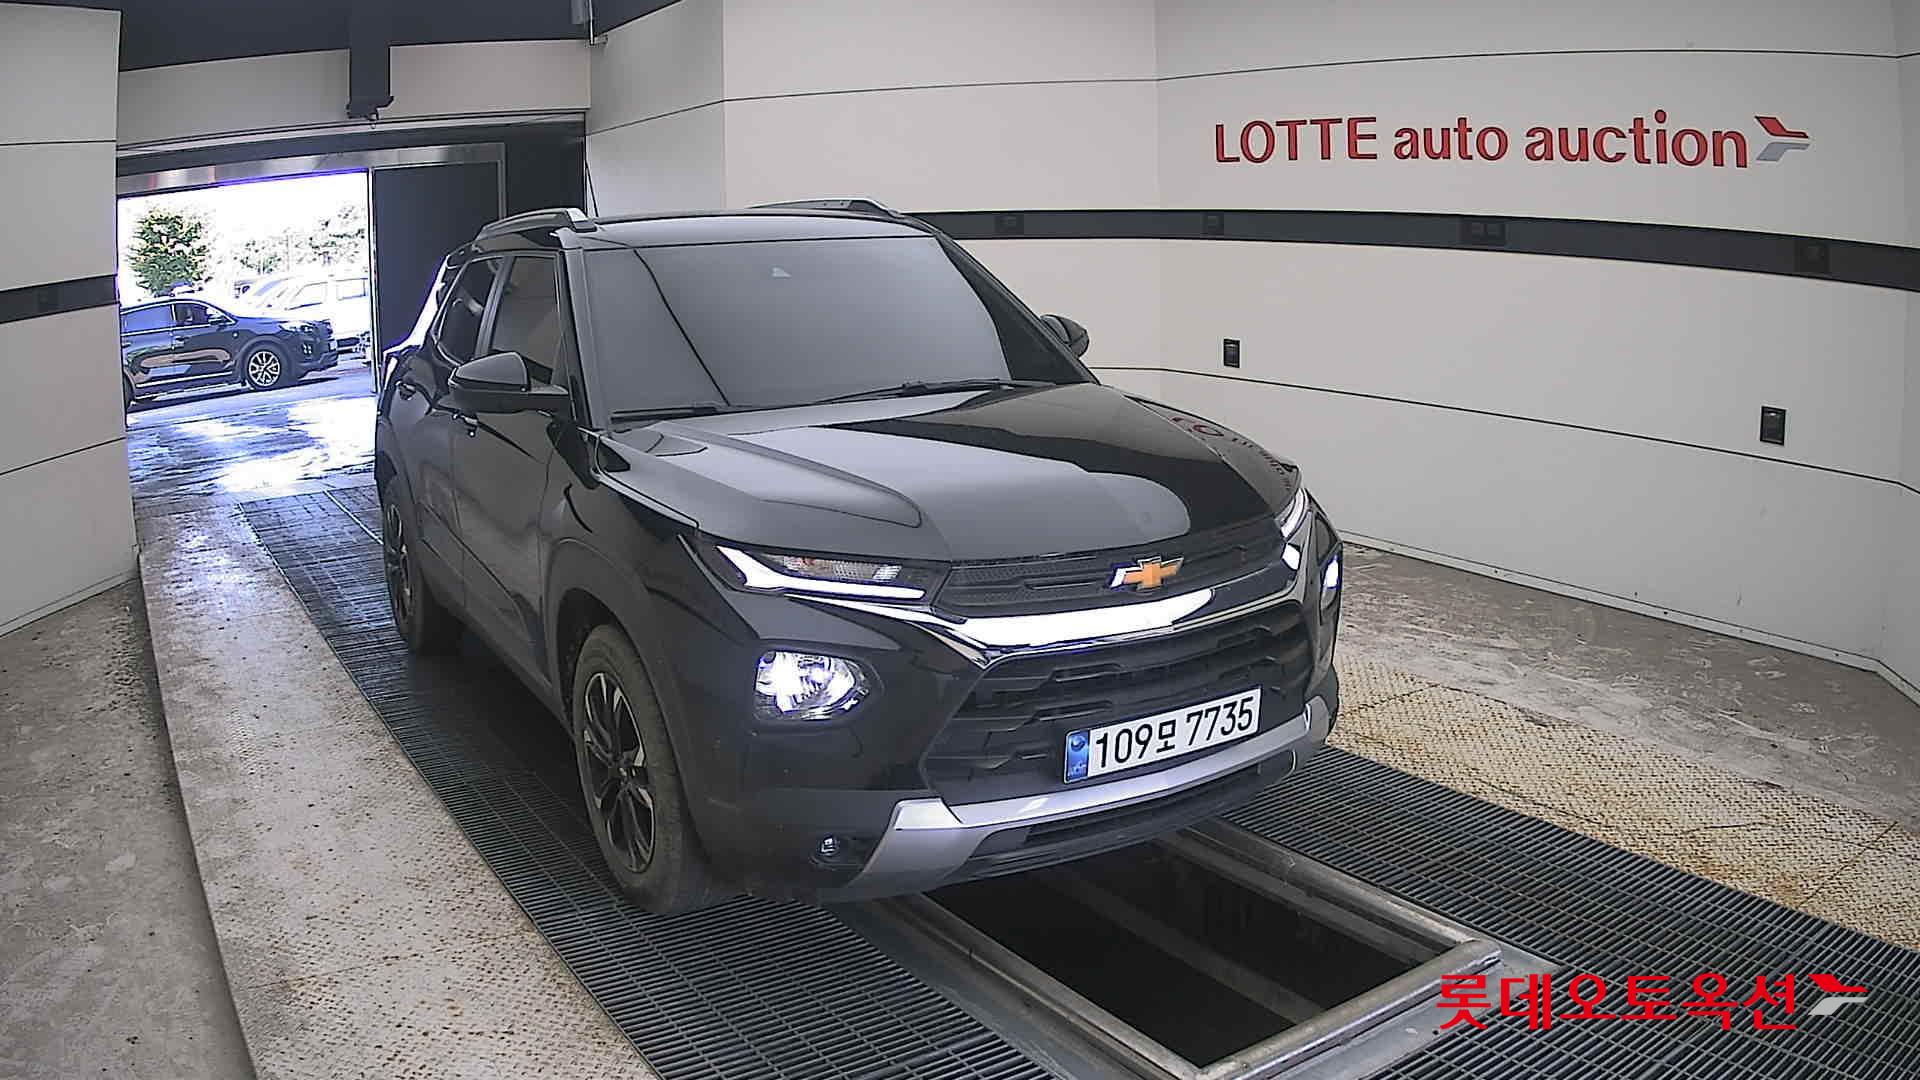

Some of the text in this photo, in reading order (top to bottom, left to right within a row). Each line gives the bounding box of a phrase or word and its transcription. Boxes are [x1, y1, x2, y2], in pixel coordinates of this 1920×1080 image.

[1215, 109, 1748, 168] LOTTE auto auction
[1096, 696, 1254, 768] 109모 7735
